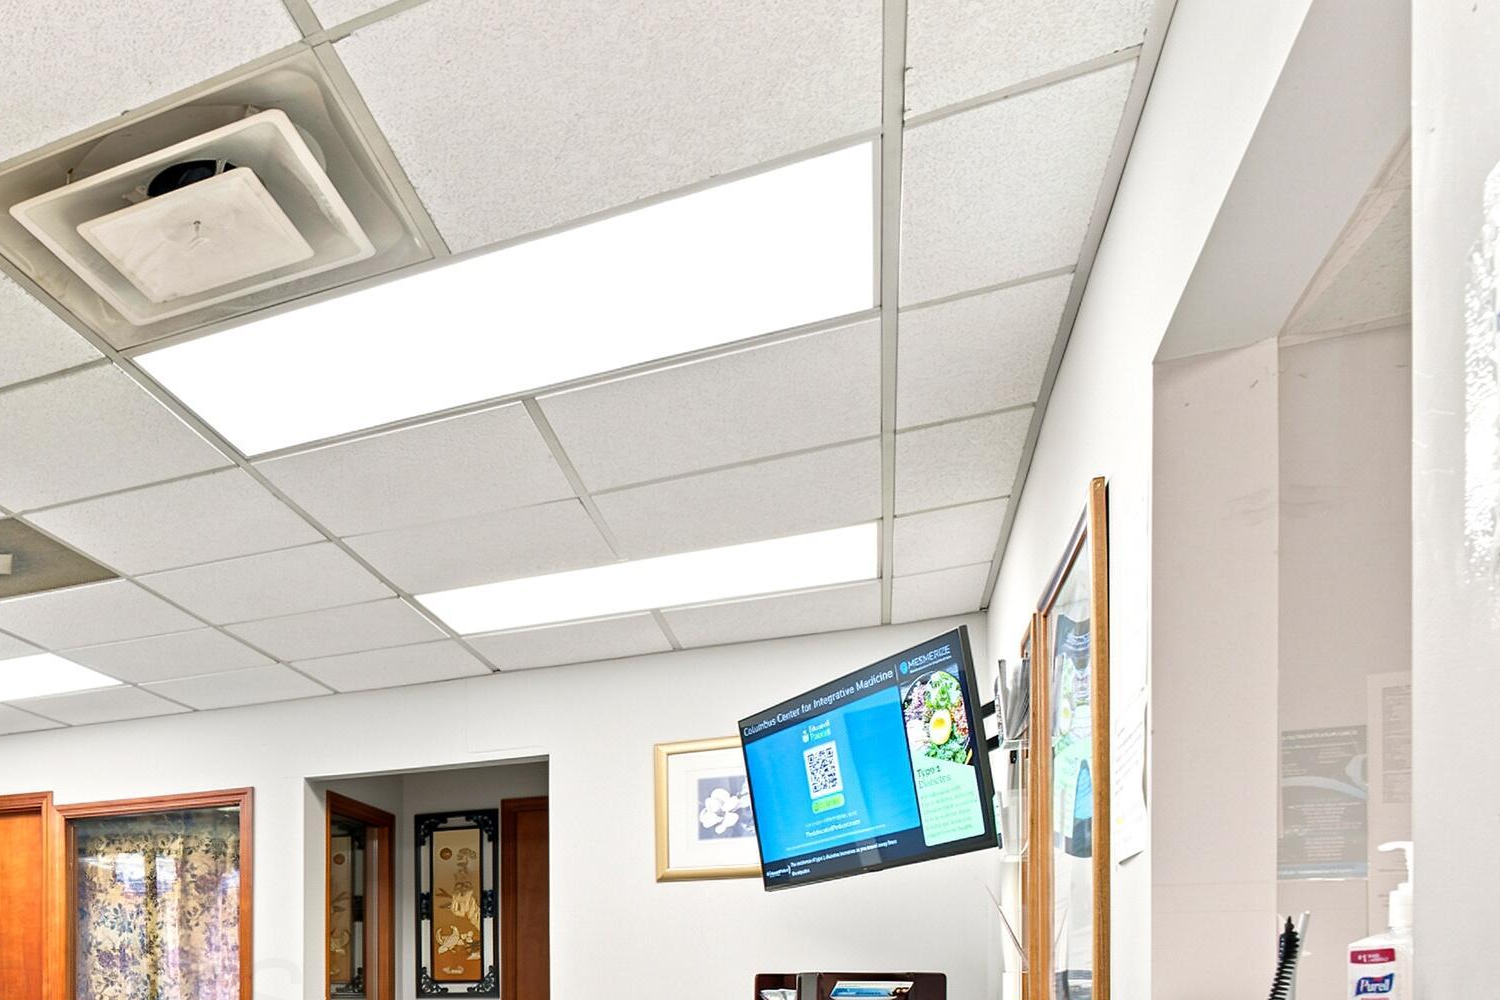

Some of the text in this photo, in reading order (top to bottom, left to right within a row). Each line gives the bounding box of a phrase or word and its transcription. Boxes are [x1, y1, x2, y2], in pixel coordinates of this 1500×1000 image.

[908, 645, 951, 668] MESMERIZE
[744, 670, 893, 736] Columbus Center for Integrative Medicine
